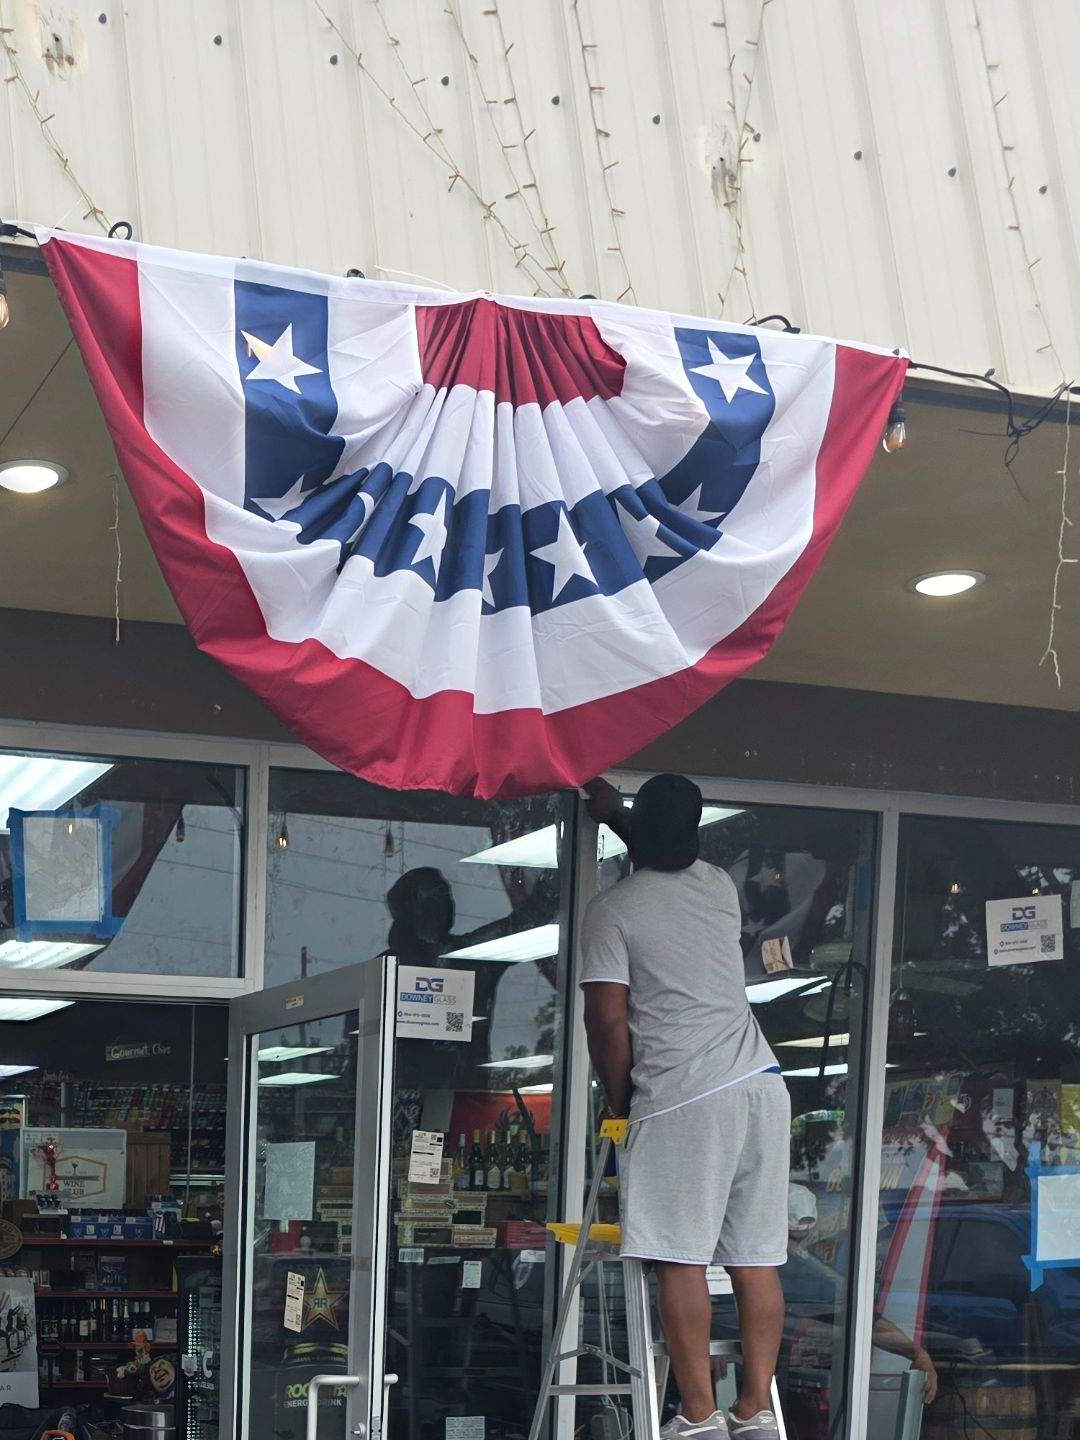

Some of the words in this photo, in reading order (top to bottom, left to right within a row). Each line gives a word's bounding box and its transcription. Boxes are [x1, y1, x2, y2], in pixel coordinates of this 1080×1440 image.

[1012, 905, 1036, 920] DG
[415, 976, 444, 992] DG
[401, 992, 433, 1003] DOWNEY
